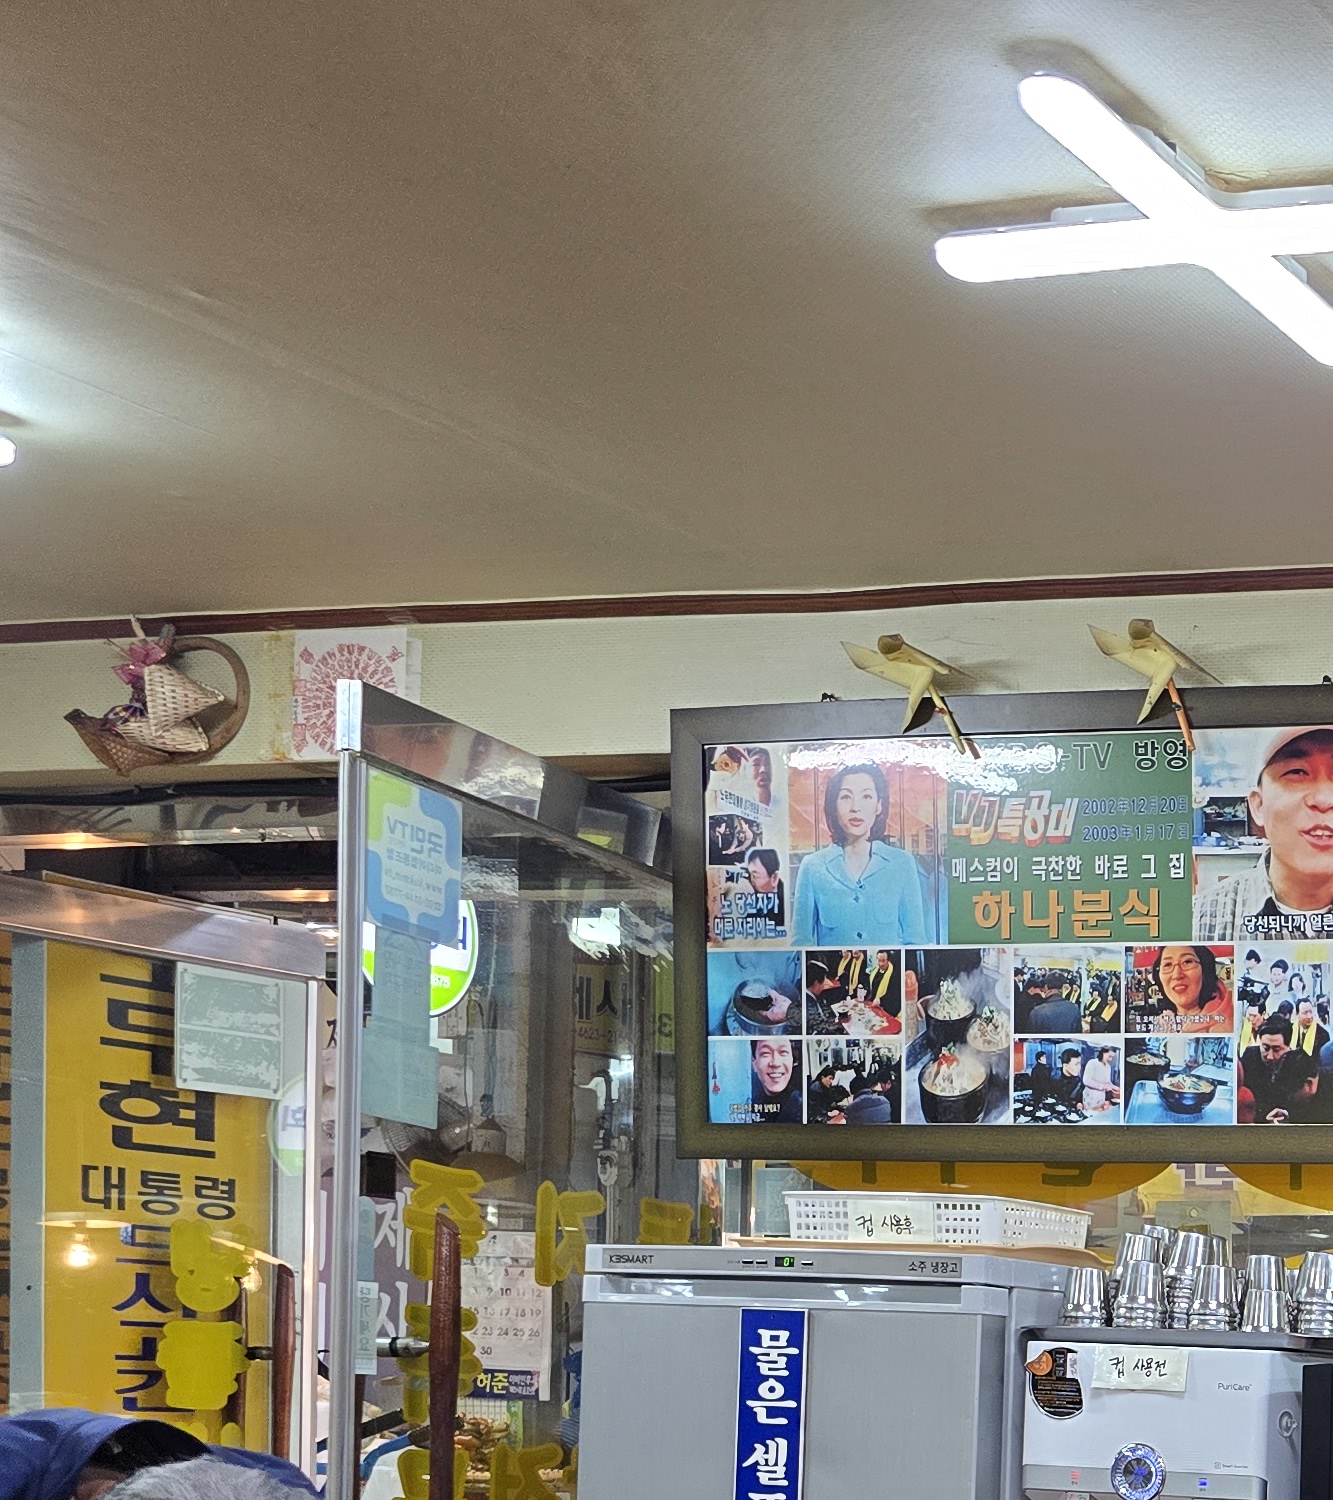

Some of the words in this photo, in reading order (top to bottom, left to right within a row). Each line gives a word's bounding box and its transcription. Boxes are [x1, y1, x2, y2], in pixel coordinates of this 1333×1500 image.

[1132, 738, 1189, 772] 방영
[951, 856, 1019, 883] 메스컴이
[1031, 855, 1082, 881] 극찬한
[1095, 854, 1130, 880] 바로
[1140, 855, 1157, 878] 그
[1168, 853, 1185, 878] 집
[720, 893, 732, 913] 노
[735, 892, 780, 915] 당선자가
[972, 888, 1160, 940] 하나분식
[1244, 913, 1305, 933] 당선되니까
[80, 1163, 238, 1222] 대통령
[855, 1214, 875, 1237] 컵
[880, 1213, 915, 1235] 사용후
[908, 1261, 928, 1273] 소주
[930, 1260, 959, 1274] 냉장고
[500, 1288, 512, 1297] 10
[481, 1327, 494, 1337] 23
[497, 1327, 509, 1337] 24
[512, 1327, 525, 1337] 25
[528, 1327, 540, 1338] 26
[480, 1346, 492, 1355] 30
[746, 1328, 800, 1425] 물은
[1109, 1356, 1126, 1378] 컵
[1133, 1357, 1168, 1378] 사용전
[476, 1372, 509, 1394] 허준
[1217, 1382, 1252, 1392] PuriCare
